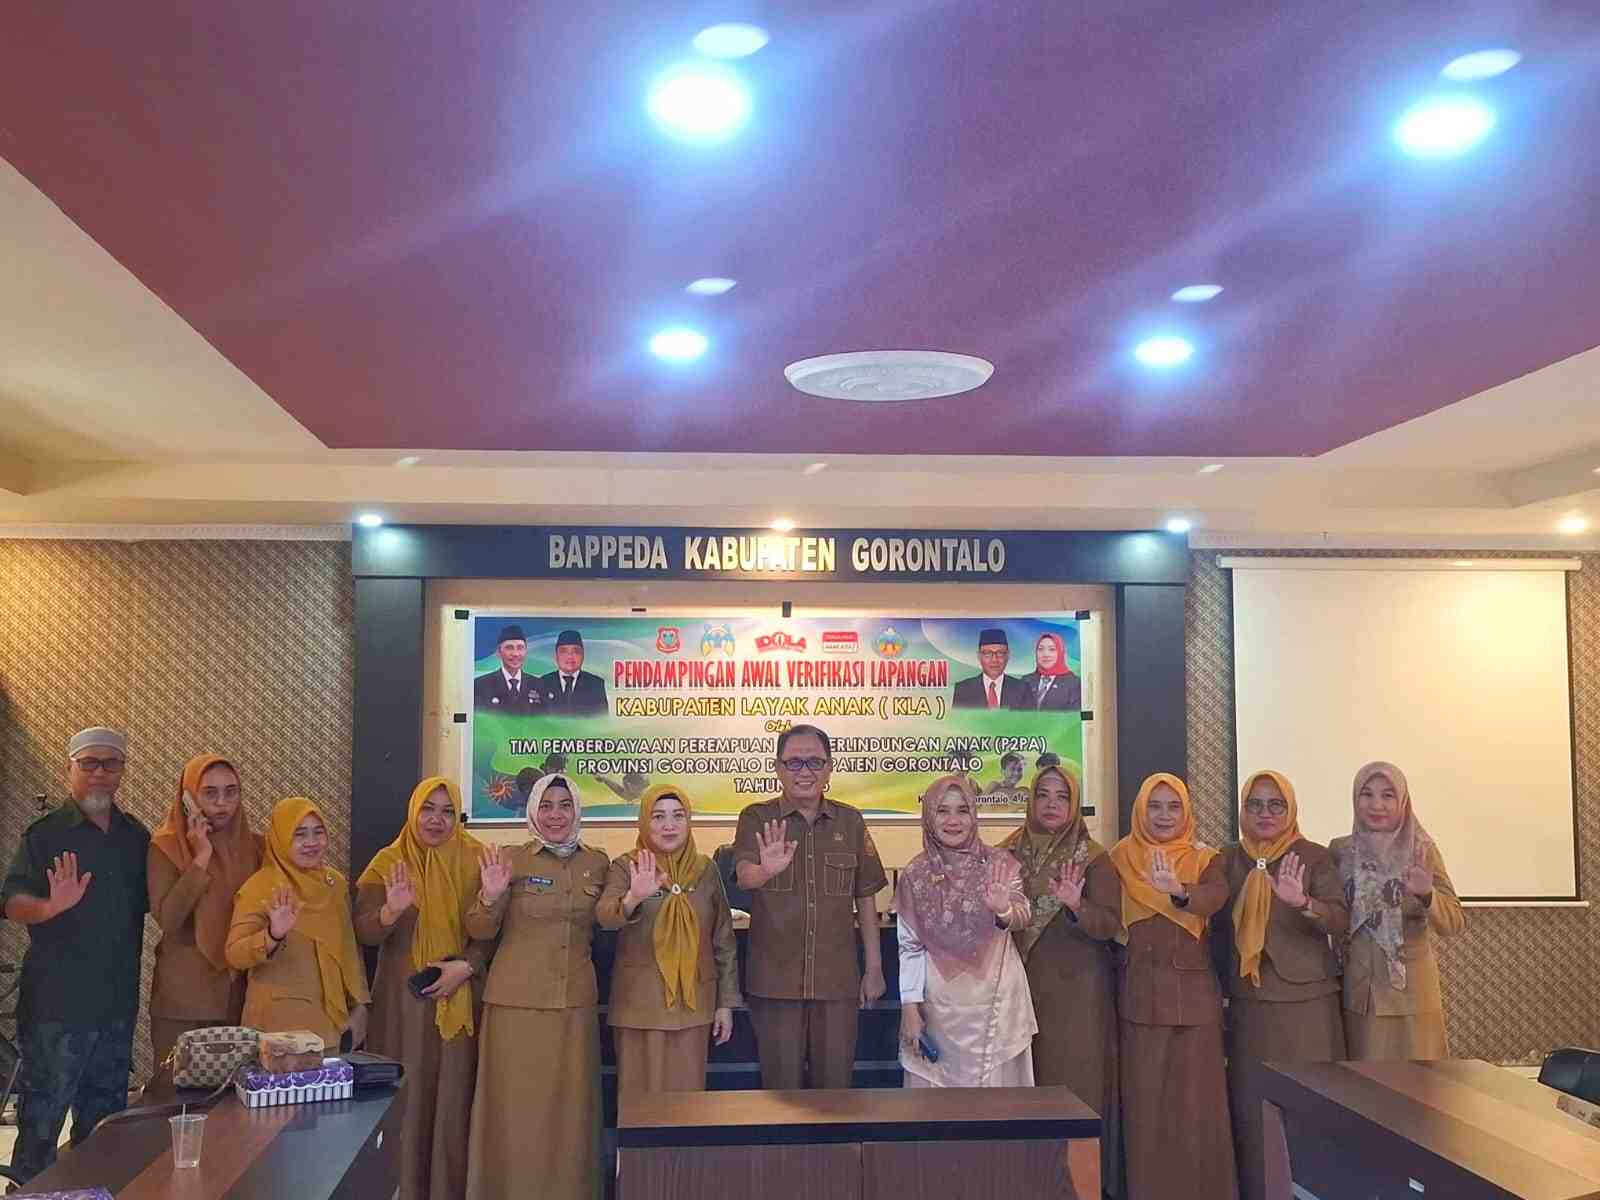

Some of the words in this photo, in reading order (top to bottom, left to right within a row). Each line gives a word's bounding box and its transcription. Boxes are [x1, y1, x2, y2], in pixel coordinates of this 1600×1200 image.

[549, 534, 667, 569] BAPPEDA
[685, 536, 835, 571] KABUPATEN
[852, 538, 1005, 573] GORONTALO
[614, 661, 735, 688] PENDAMPINGAN
[741, 661, 781, 688] AWAL
[786, 660, 865, 687] VERIFIKASI
[871, 660, 948, 687] LAPANGAN
[616, 697, 736, 716] KABUPATEN
[741, 697, 808, 716] LAYAK
[814, 697, 874, 715] ANAK
[510, 738, 537, 754] TIM
[542, 738, 675, 754] PEMBERDAYAAN
[680, 737, 775, 753] PEREMPUAN
[828, 736, 940, 752] ERLINDUNGAN
[945, 736, 992, 752] ANAK
[994, 735, 1048, 754] (P2PA)
[577, 758, 652, 775] PROVINSI
[657, 757, 762, 774] GORONTALO
[880, 755, 983, 772] GORONTALO
